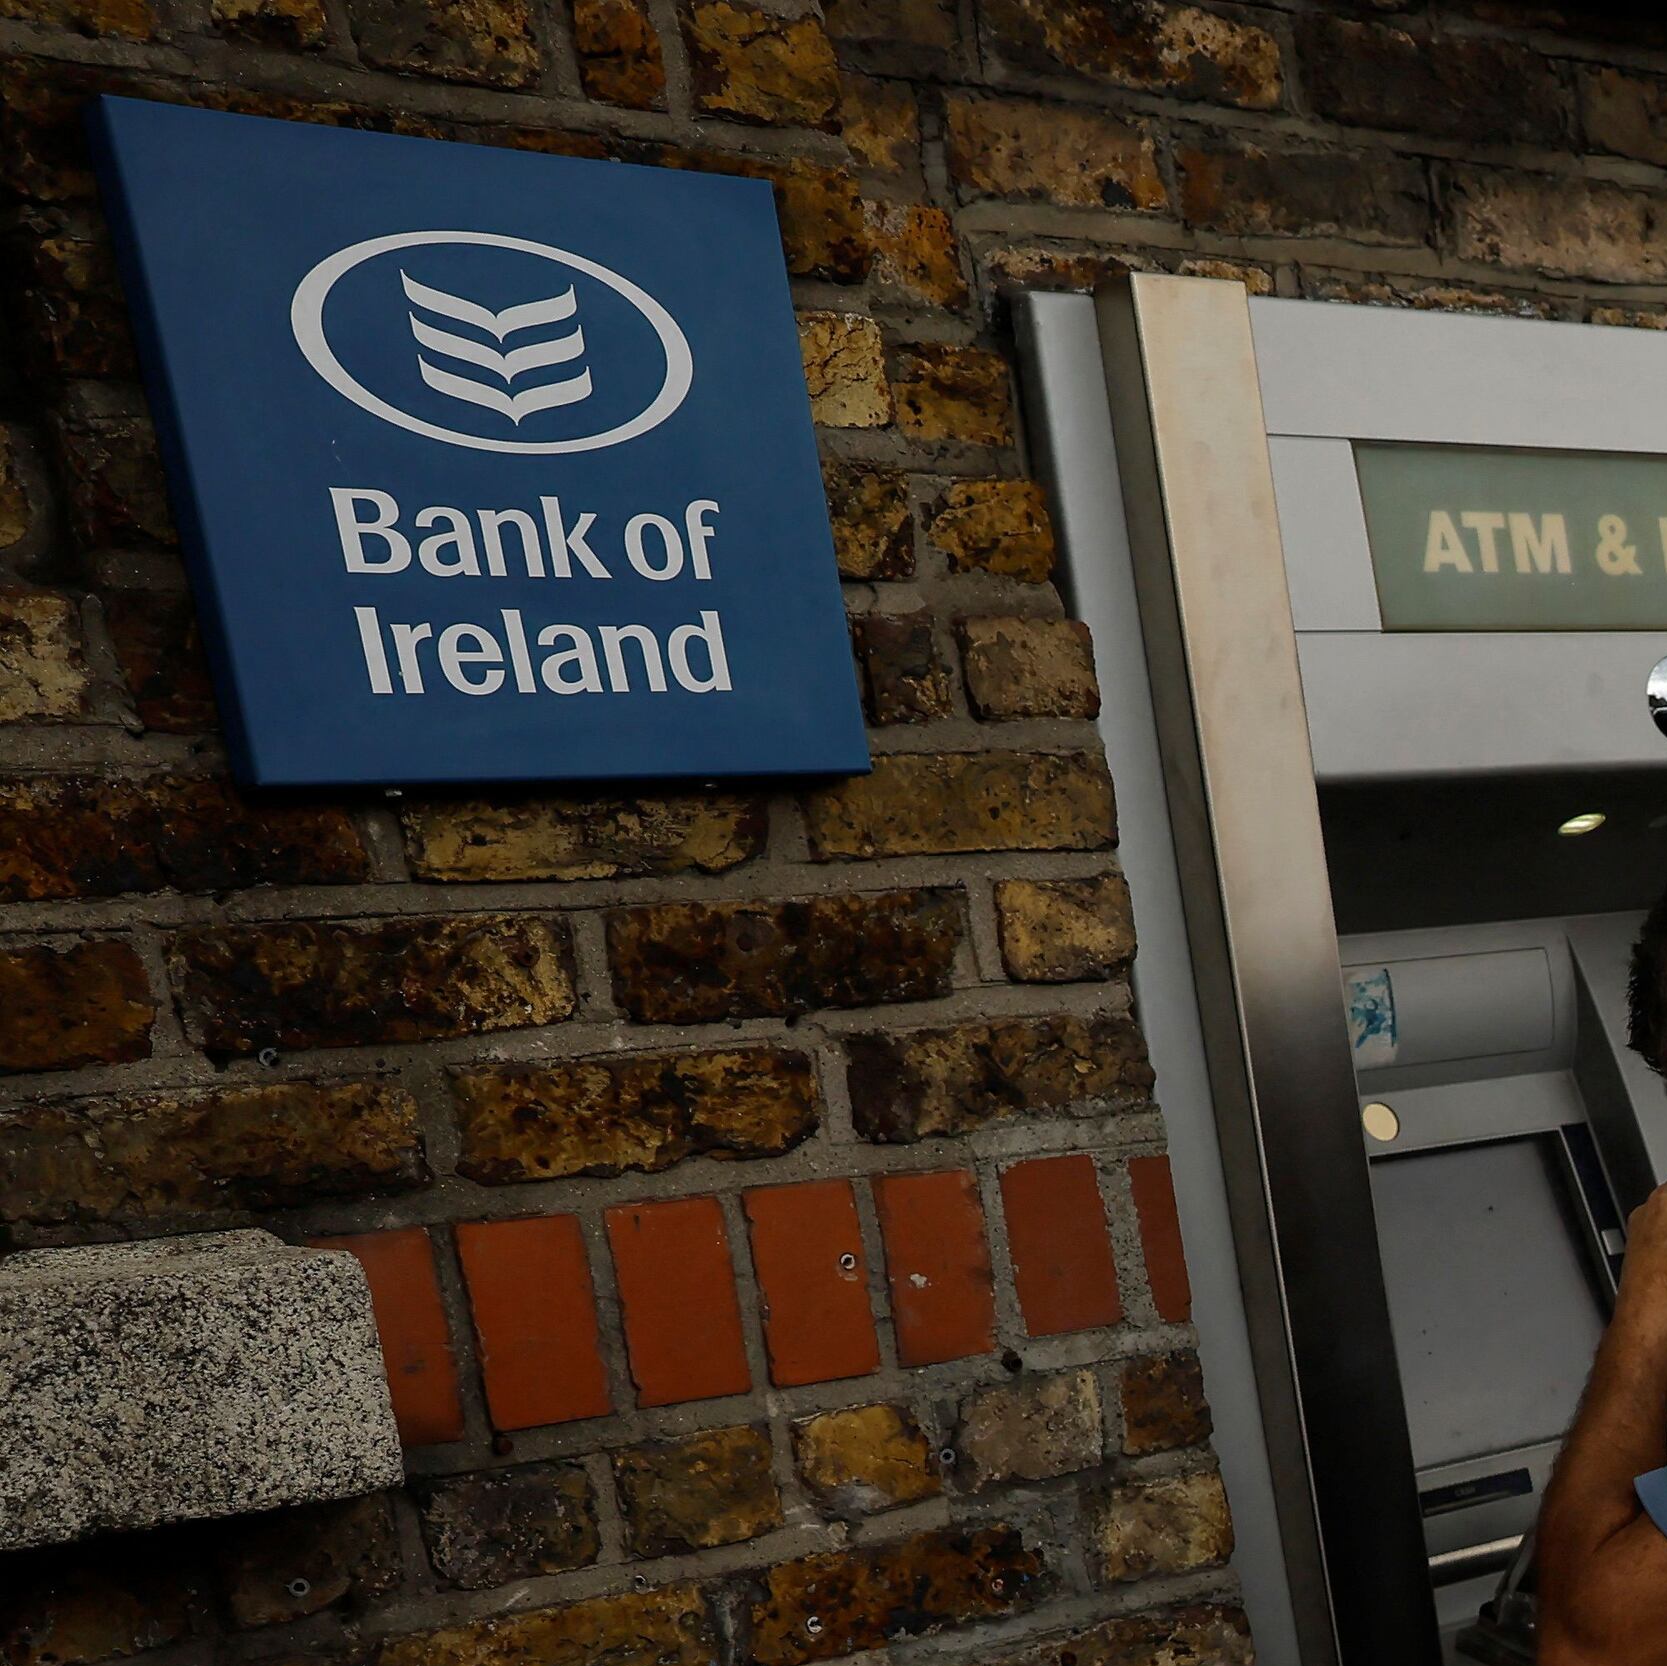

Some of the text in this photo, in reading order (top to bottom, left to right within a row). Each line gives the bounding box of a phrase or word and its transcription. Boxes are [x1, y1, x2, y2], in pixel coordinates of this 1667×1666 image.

[328, 487, 719, 580] Bank of
[1425, 512, 1569, 572] ATM
[1596, 516, 1640, 576] &
[354, 607, 732, 695] Ireland
